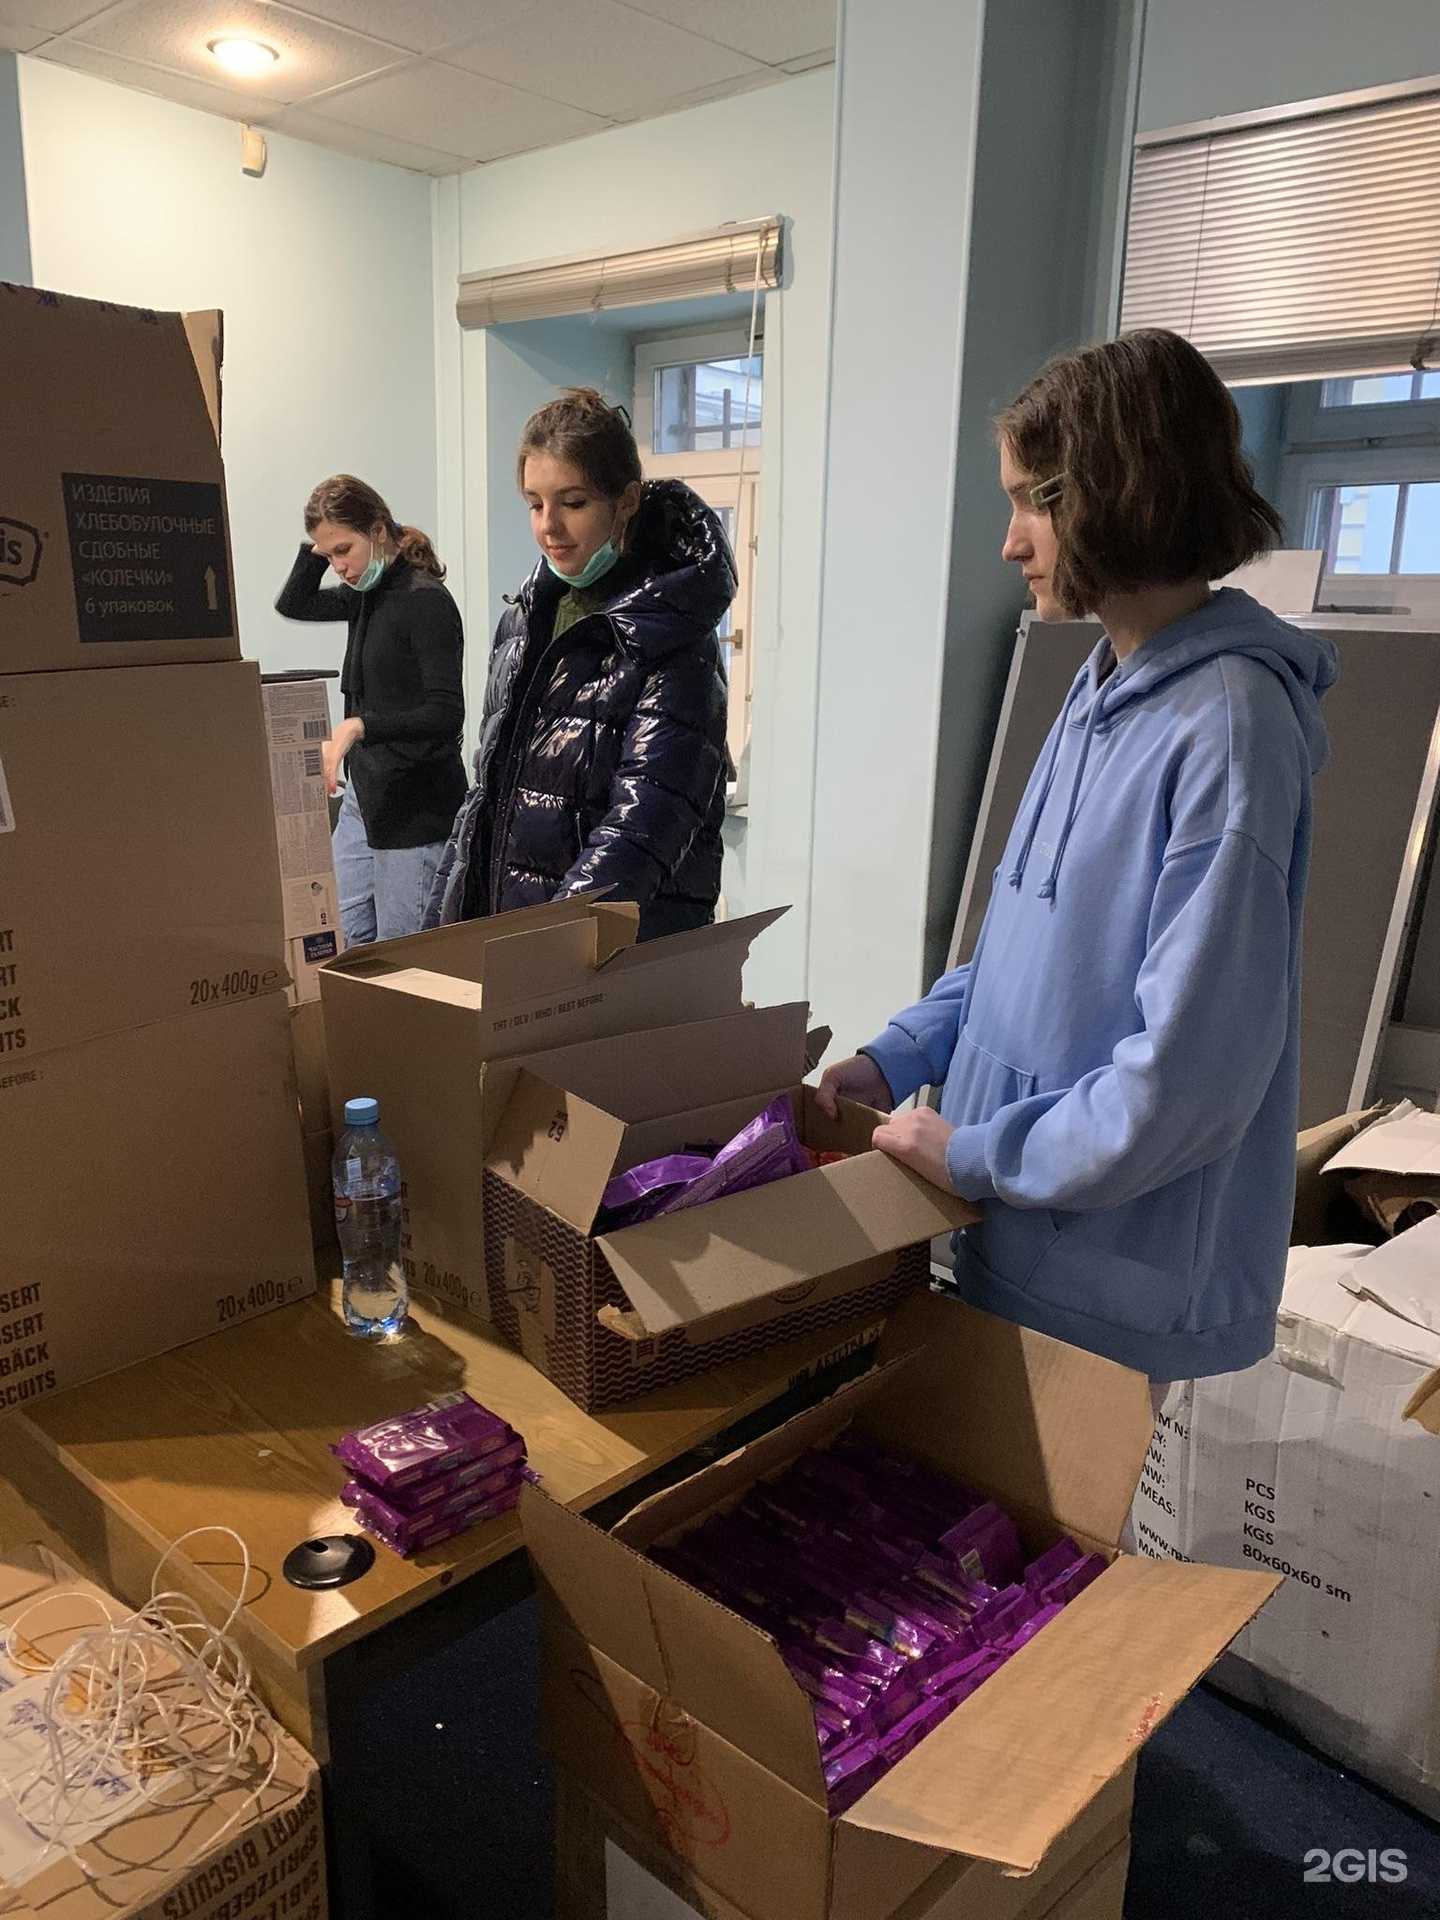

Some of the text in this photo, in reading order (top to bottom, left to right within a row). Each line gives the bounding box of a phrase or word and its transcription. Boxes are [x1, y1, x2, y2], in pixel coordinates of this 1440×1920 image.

[72, 483, 151, 505] ИЗДЕЛИЯ
[75, 512, 217, 535] ХЛЕБОБУЛОЧНЫЕ
[79, 541, 161, 561] СДОБНЫЕ
[85, 596, 175, 618] 6 упаковок
[1140, 1481, 1176, 1518] MEAS:
[1246, 1478, 1276, 1500] PCS
[1244, 1500, 1275, 1524] KGS
[1243, 1522, 1274, 1546] KGS
[1242, 1544, 1351, 1603] 80x60x60 sm
[161, 1838, 260, 1919] BISCUITS
